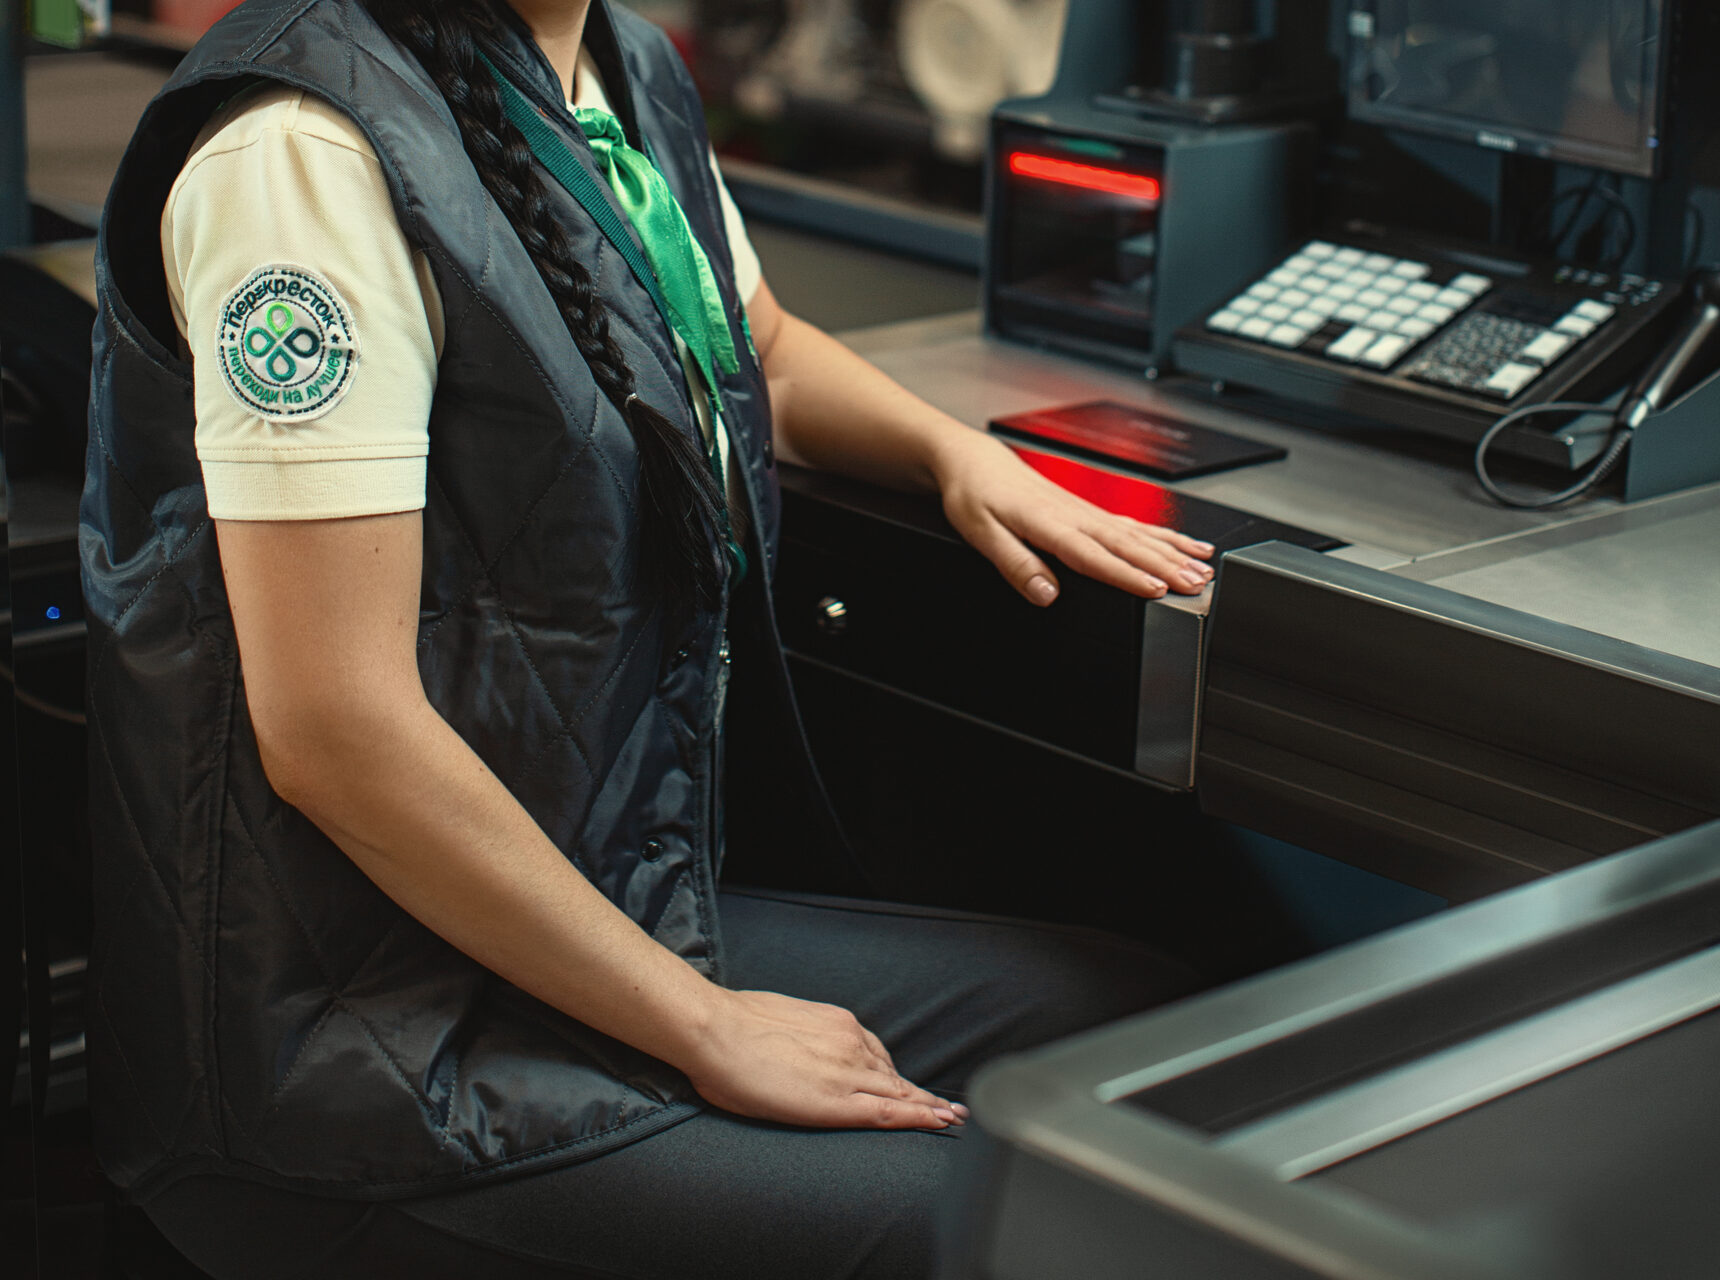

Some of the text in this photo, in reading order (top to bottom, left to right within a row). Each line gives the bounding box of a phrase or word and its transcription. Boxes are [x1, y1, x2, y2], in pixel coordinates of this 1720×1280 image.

[229, 346, 342, 404] переходи на лучшее
